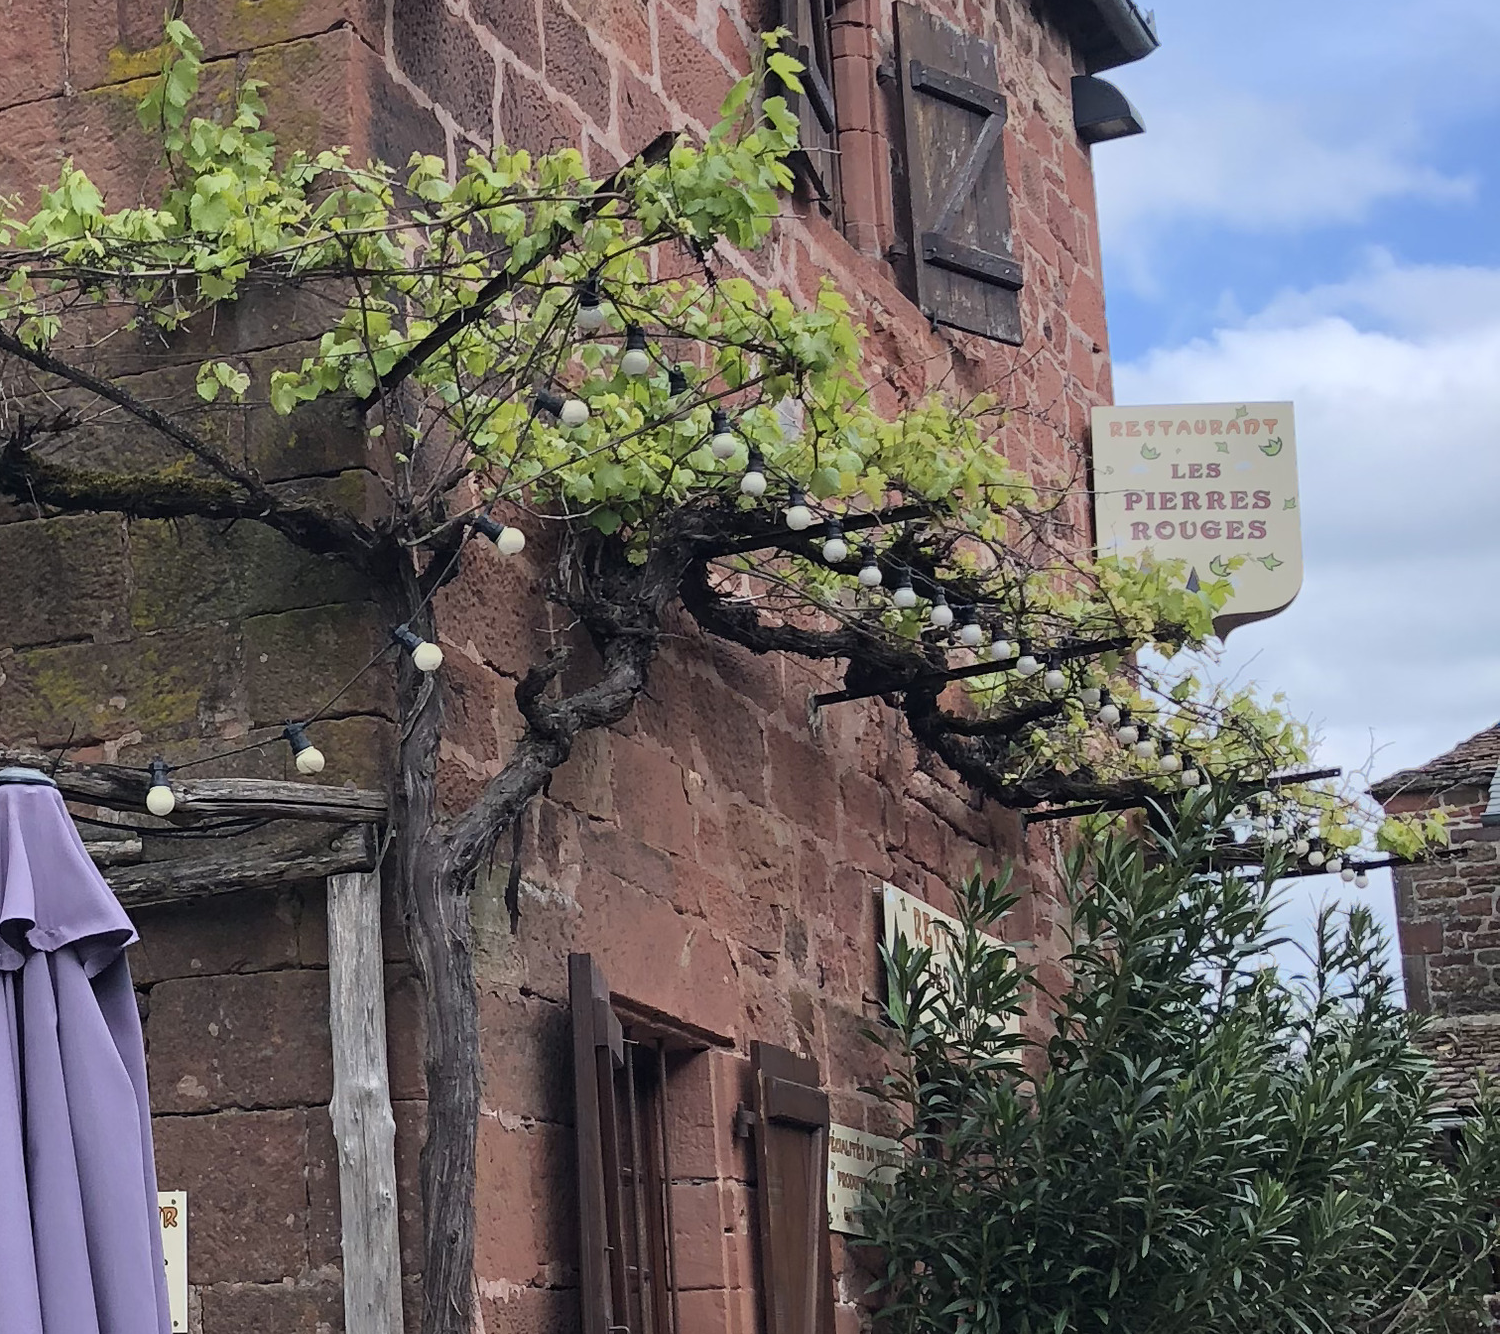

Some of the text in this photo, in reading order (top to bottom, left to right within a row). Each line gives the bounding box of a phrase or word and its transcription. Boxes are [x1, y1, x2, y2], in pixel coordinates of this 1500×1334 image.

[1109, 419, 1279, 438] RESTAURANT
[1171, 463, 1222, 480] LES
[1123, 490, 1272, 511] PIERRES
[1130, 520, 1268, 541] ROUGES
